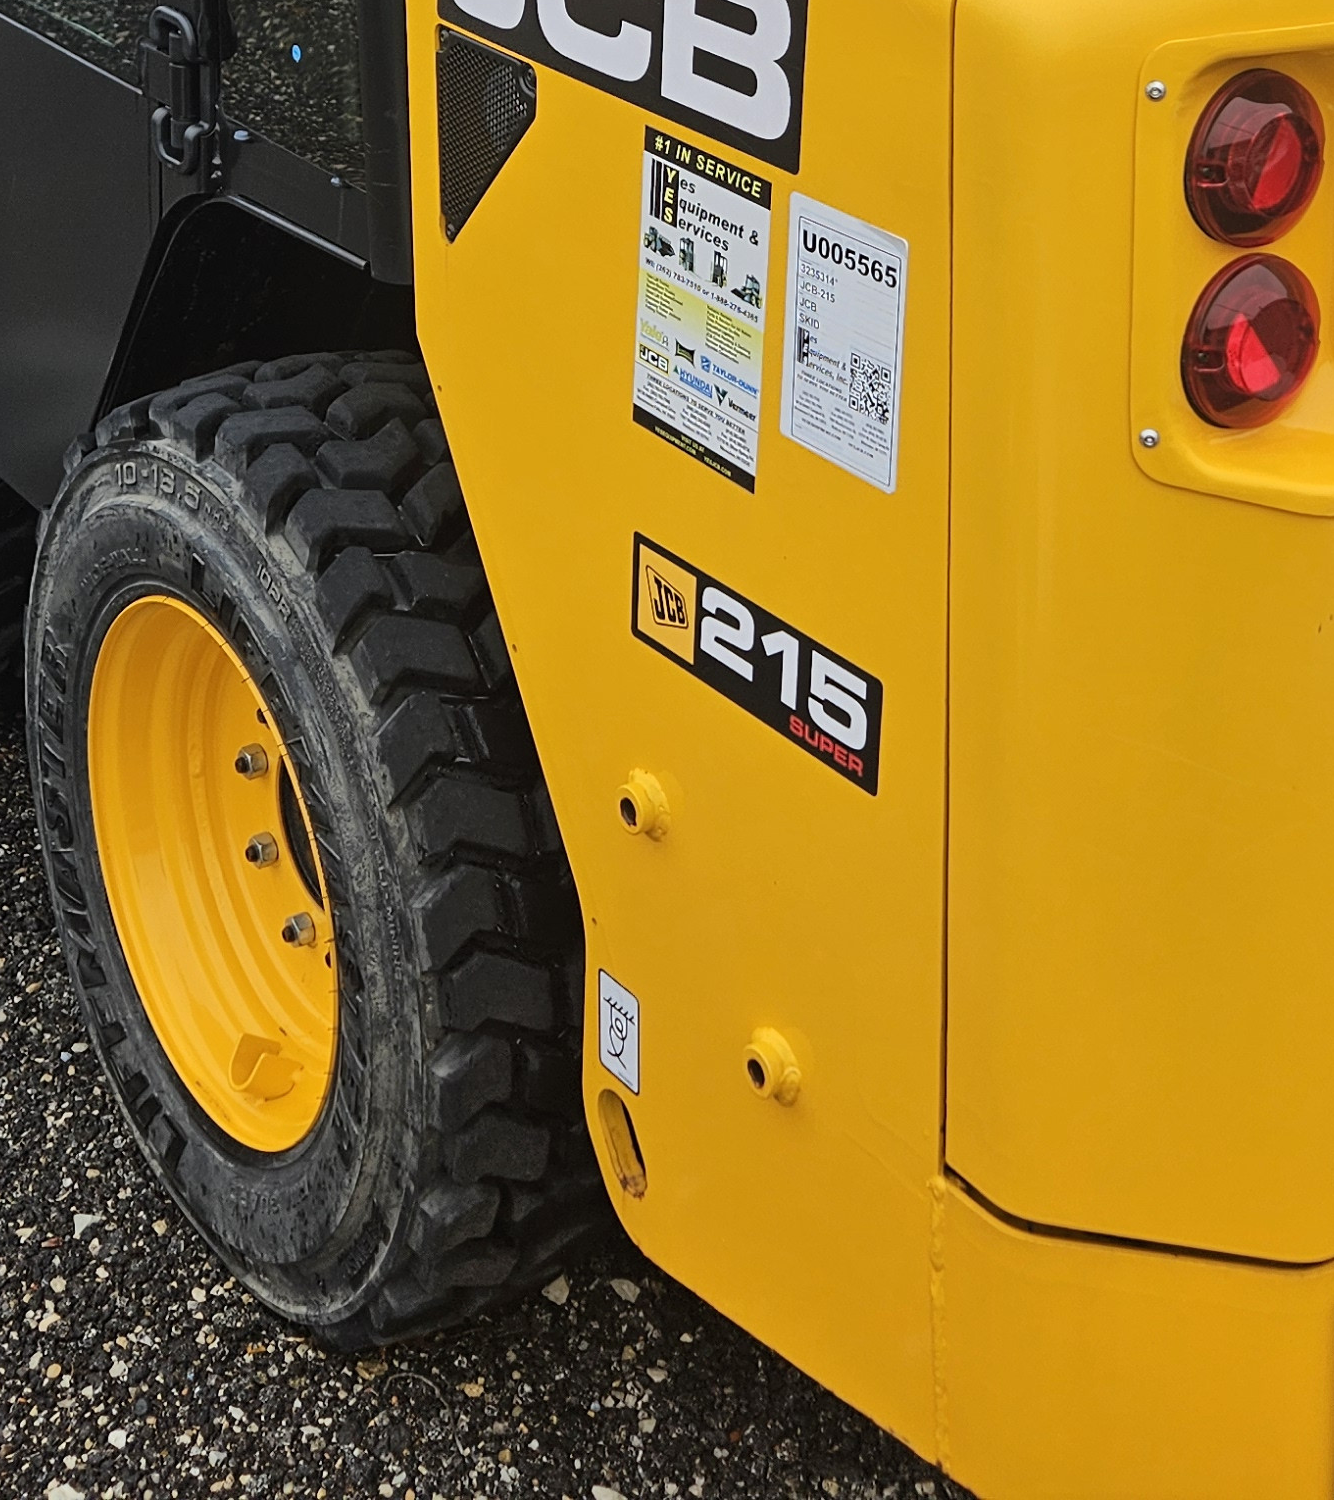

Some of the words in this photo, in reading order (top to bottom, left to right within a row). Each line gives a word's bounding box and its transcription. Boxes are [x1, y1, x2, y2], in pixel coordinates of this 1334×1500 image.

[654, 135, 671, 155] #1
[675, 144, 692, 165] IN
[695, 154, 762, 199] SERVICE
[748, 230, 760, 247] &
[802, 228, 898, 289] U005565
[701, 288, 709, 297] or
[799, 297, 818, 313] JCB
[800, 280, 836, 304] JCB-215
[798, 312, 821, 331] SKID
[640, 344, 668, 372] JCB
[679, 367, 713, 395] HYUNDAI
[712, 363, 757, 396] TAYLOR-DUNN
[115, 460, 203, 510] 10-16.5
[652, 575, 686, 625] JCB
[699, 586, 868, 751] 215
[789, 713, 865, 778] SUPER
